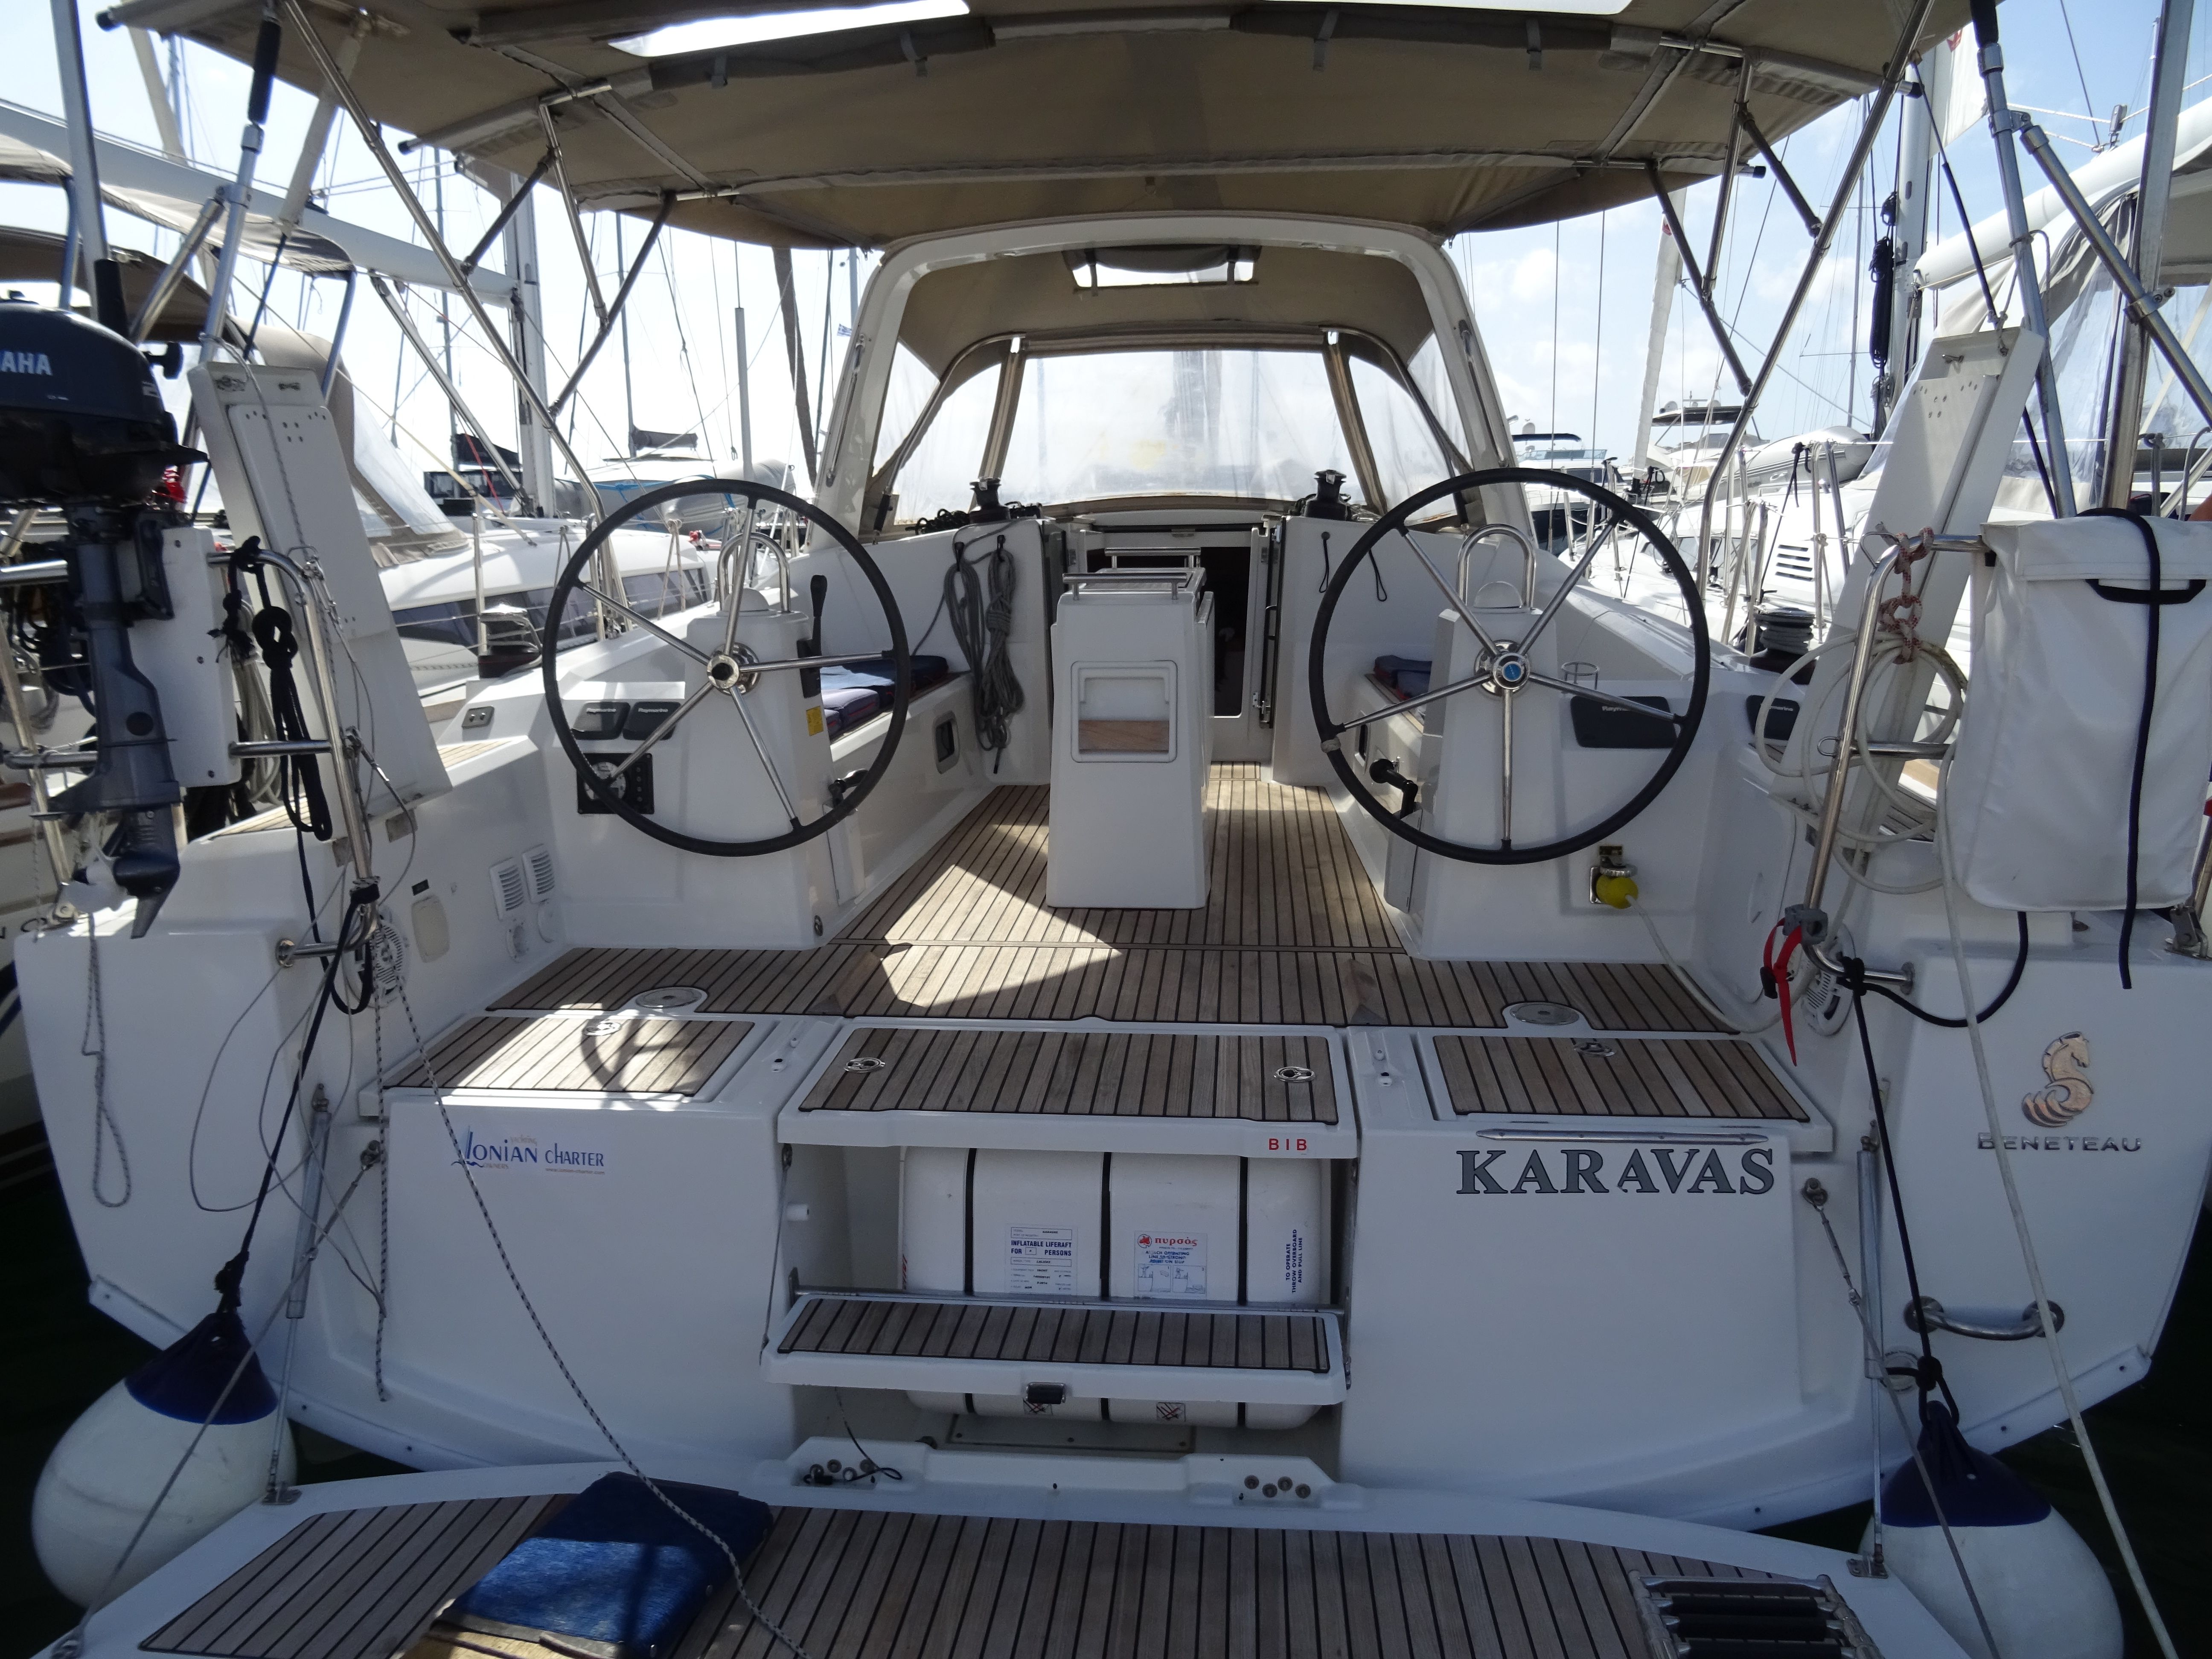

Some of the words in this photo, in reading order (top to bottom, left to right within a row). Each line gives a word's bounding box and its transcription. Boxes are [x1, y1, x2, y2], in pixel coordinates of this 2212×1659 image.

[0, 351, 53, 375] AHA
[1977, 1132, 2142, 1152] BENETEAU
[1456, 1148, 1775, 1195] KARAVAS
[1155, 1237, 1198, 1246] πυρσός
[1286, 1272, 1290, 1281] TO
